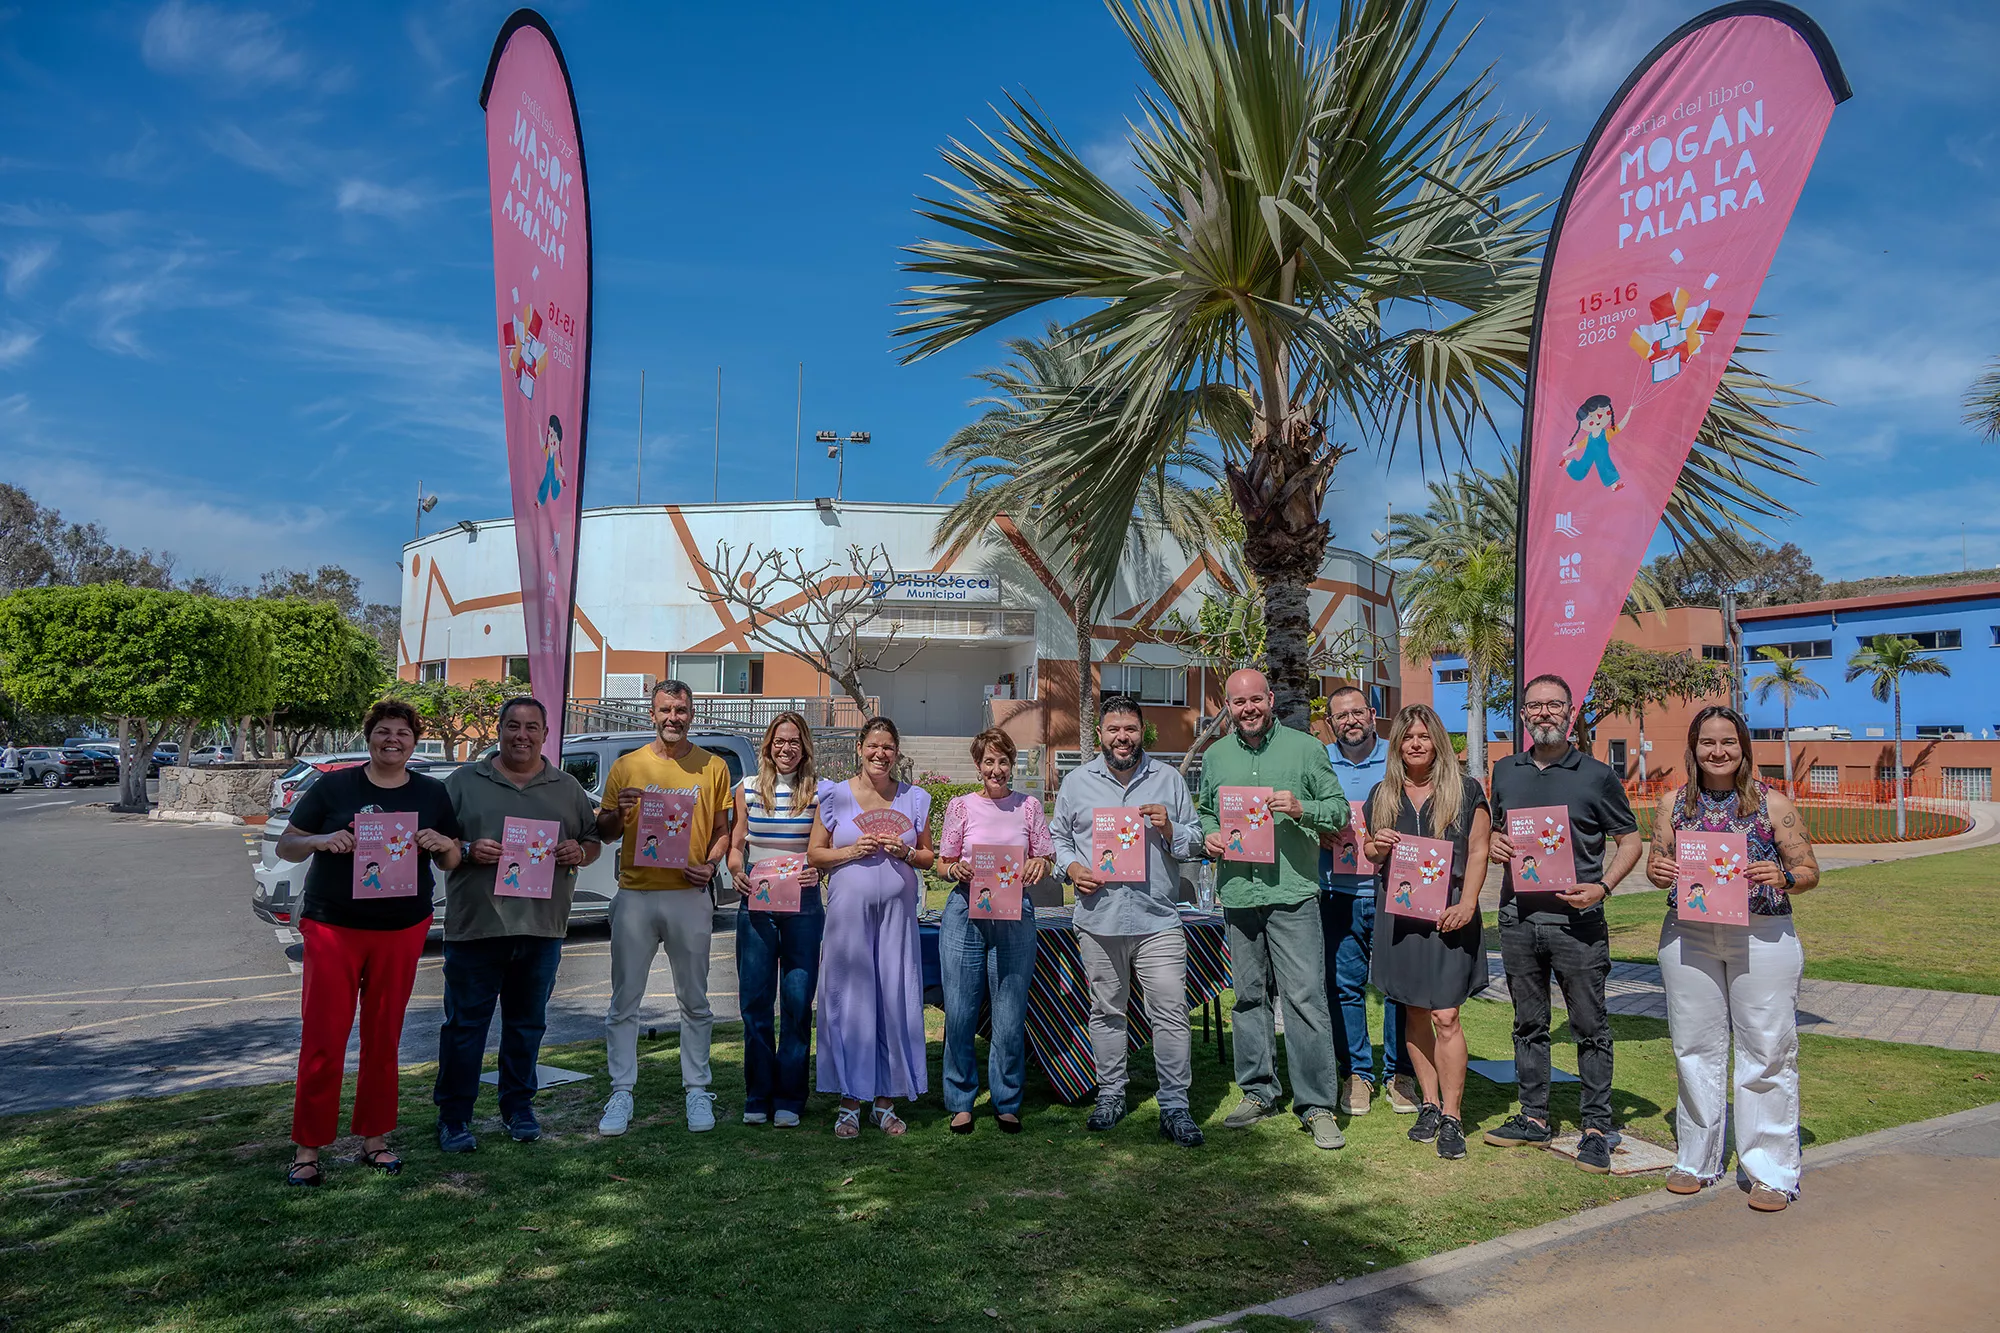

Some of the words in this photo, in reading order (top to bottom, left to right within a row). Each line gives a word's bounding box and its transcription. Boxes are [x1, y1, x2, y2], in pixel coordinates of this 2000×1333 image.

[1672, 96, 1702, 121] del
[1708, 79, 1755, 108] libro
[1619, 99, 1775, 186] MOGÁN,
[1619, 169, 1698, 217] TOMA
[1714, 149, 1757, 187] LA
[1618, 179, 1765, 249] PALABRA
[1579, 282, 1638, 315] 15-16
[1578, 317, 1595, 331] de
[1599, 307, 1637, 327] mayo
[1578, 325, 1617, 347] 2026
[906, 589, 966, 600] Municipal
[1560, 626, 1586, 637] Mogán
